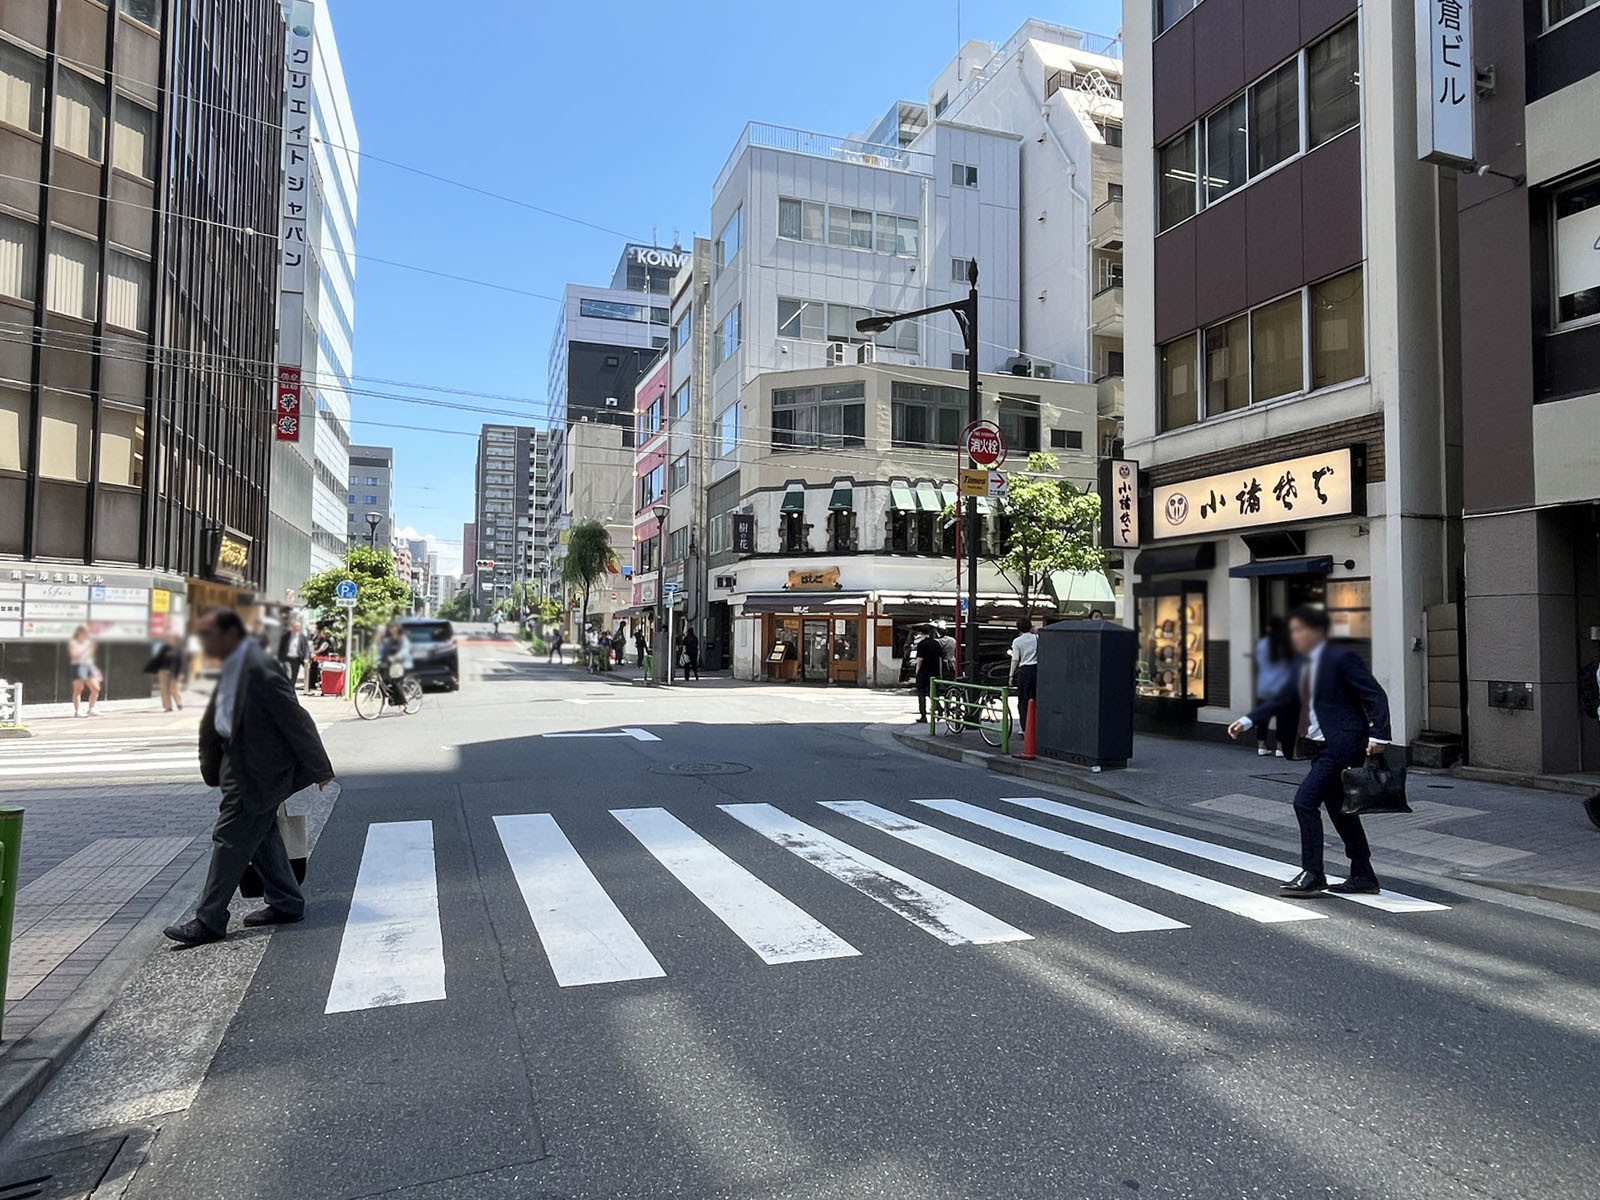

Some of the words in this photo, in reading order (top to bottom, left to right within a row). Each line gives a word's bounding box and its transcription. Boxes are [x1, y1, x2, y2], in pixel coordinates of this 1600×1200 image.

[970, 437, 998, 454] 消火栓
[963, 475, 986, 485] Times
[738, 522, 749, 550] 樹の花
